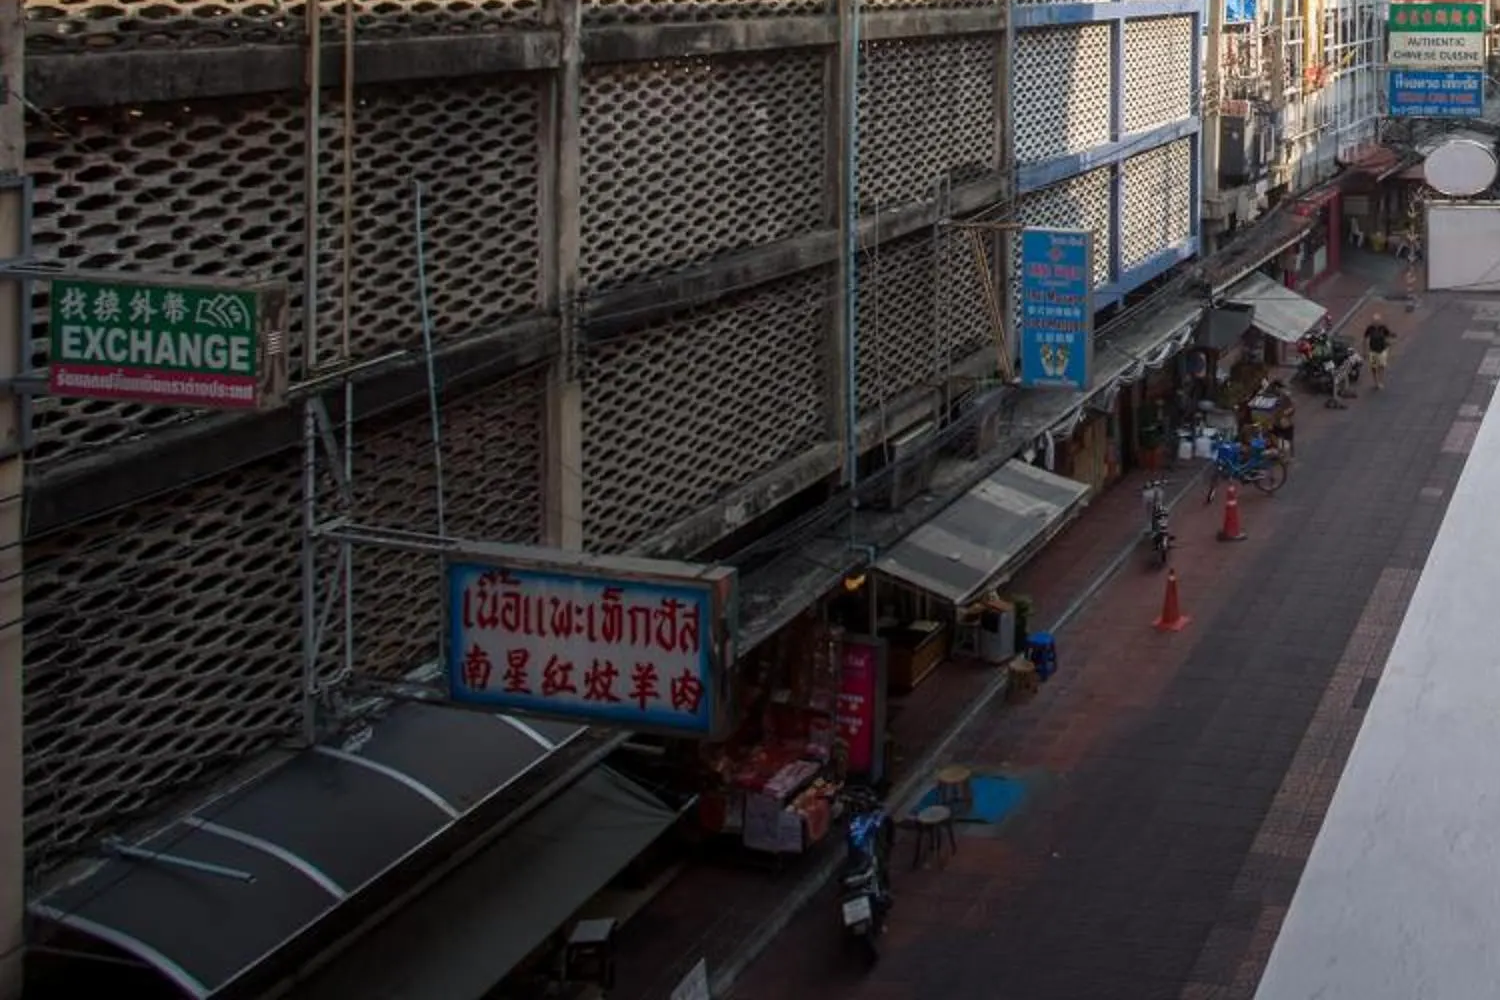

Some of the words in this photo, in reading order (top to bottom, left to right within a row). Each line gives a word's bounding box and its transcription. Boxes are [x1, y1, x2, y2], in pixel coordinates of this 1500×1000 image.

[1393, 50, 1437, 61] CHINESE
[1439, 50, 1480, 62] CUISINE
[1407, 36, 1466, 47] AUTHENTIC
[59, 286, 191, 325] 找換外幣
[60, 324, 251, 372] EXCHANGE
[462, 570, 701, 655] เนื้อแพะเท็กซัส
